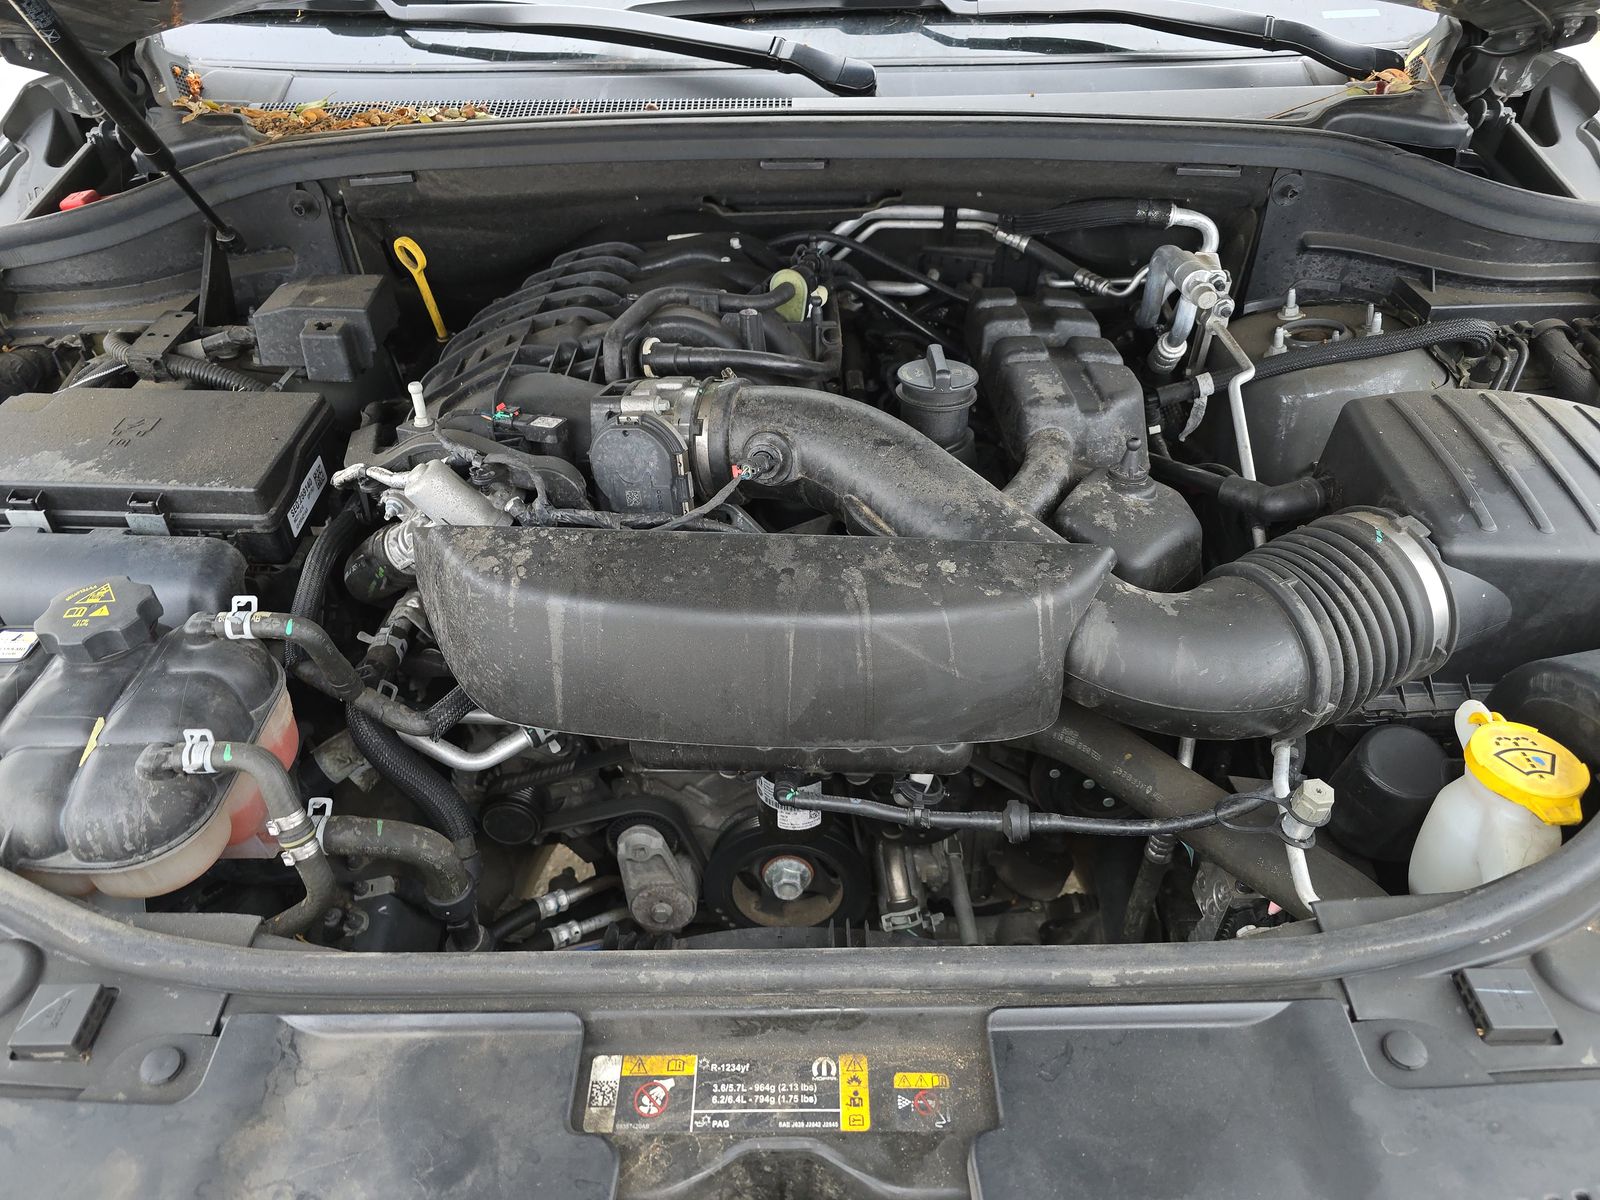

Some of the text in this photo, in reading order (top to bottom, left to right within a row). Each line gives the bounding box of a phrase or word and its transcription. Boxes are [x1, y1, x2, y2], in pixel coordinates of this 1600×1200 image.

[710, 1063, 750, 1074] R-1234yf
[712, 1083, 747, 1093] 3.6/5.7L
[754, 1083, 776, 1093] 964g
[777, 1082, 799, 1093] (2.13
[800, 1082, 818, 1093] lbs)
[711, 1095, 747, 1104] 6.2/6.4L
[754, 1095, 776, 1105] 794g
[777, 1094, 799, 1105] (1.75
[800, 1094, 818, 1105] lbs)
[711, 1119, 730, 1129] PAG
